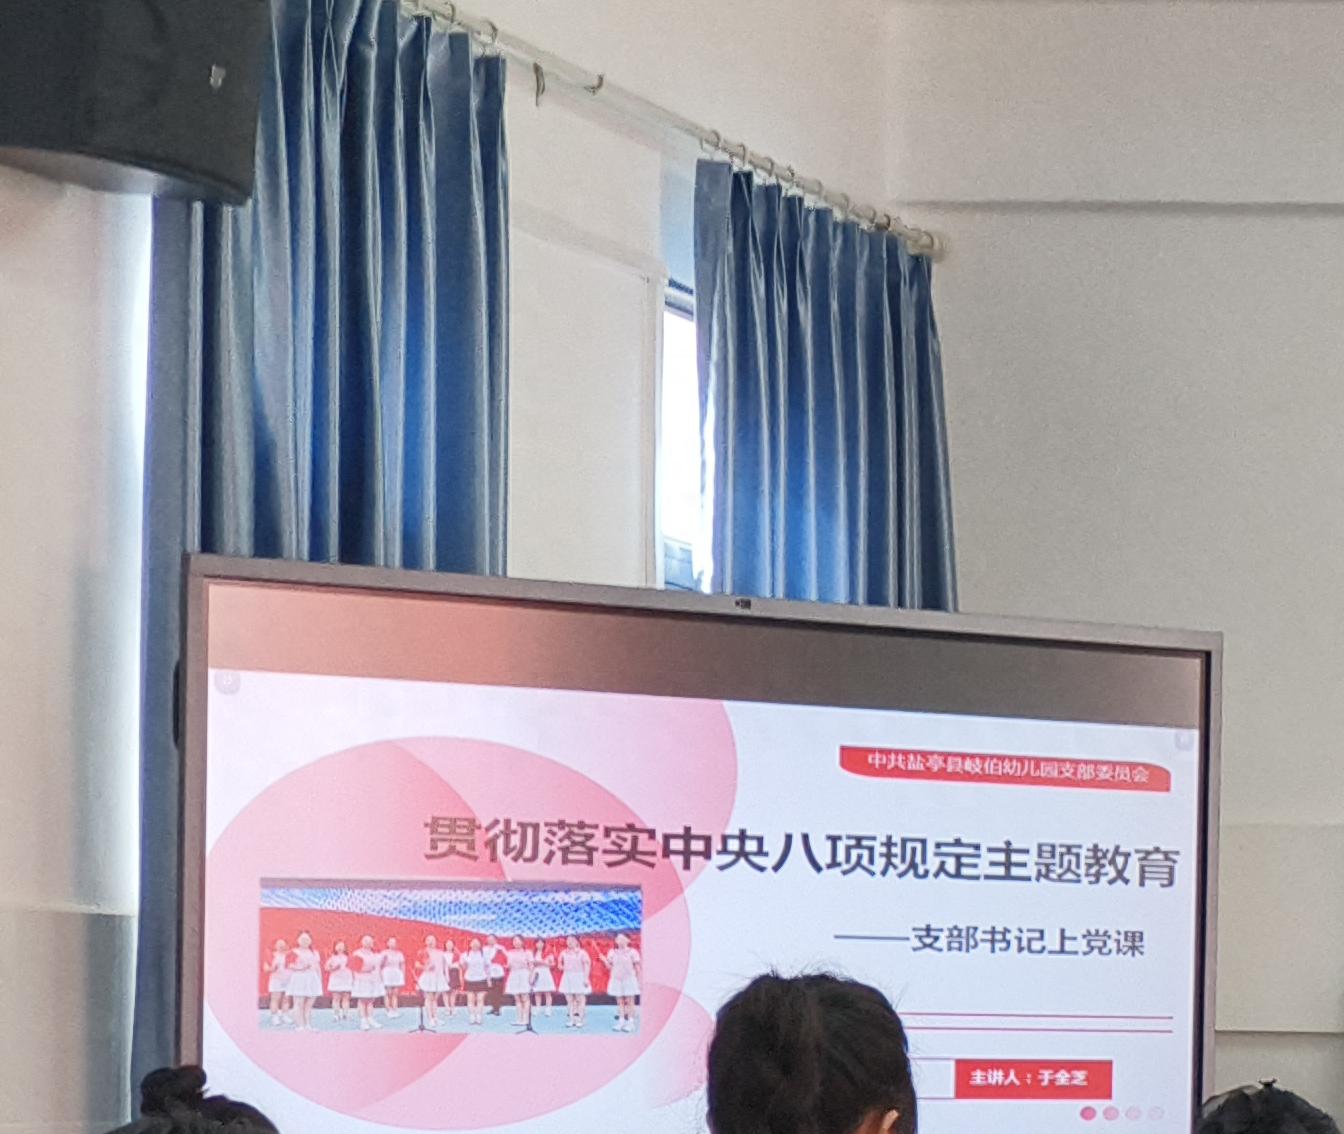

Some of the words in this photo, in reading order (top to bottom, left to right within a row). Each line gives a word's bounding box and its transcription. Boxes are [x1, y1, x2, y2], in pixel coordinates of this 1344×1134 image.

[423, 814, 1181, 888] 贯彻落实中央八项规定主题教育
